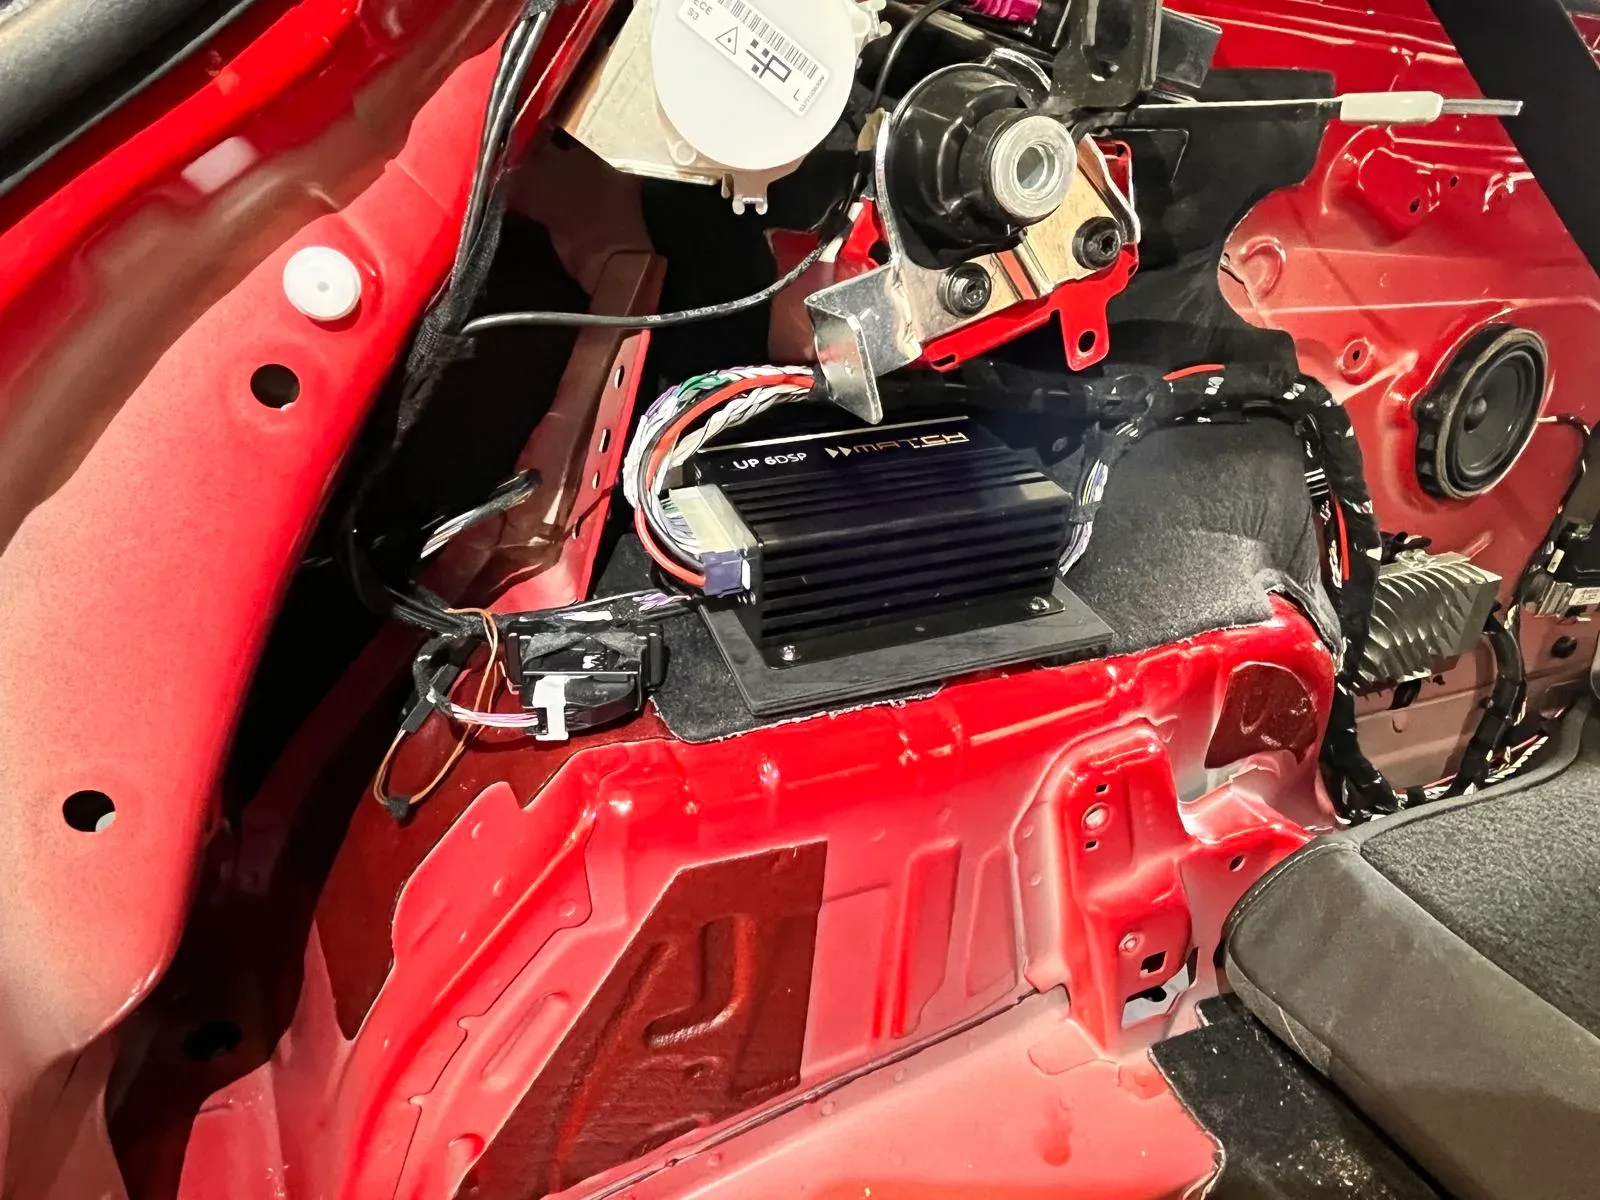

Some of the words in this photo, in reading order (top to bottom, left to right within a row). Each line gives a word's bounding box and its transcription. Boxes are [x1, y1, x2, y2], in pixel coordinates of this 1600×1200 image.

[687, 7, 700, 21] S3
[693, 0, 713, 16] ECE
[733, 458, 760, 471] UP
[764, 452, 808, 466] 6DSP
